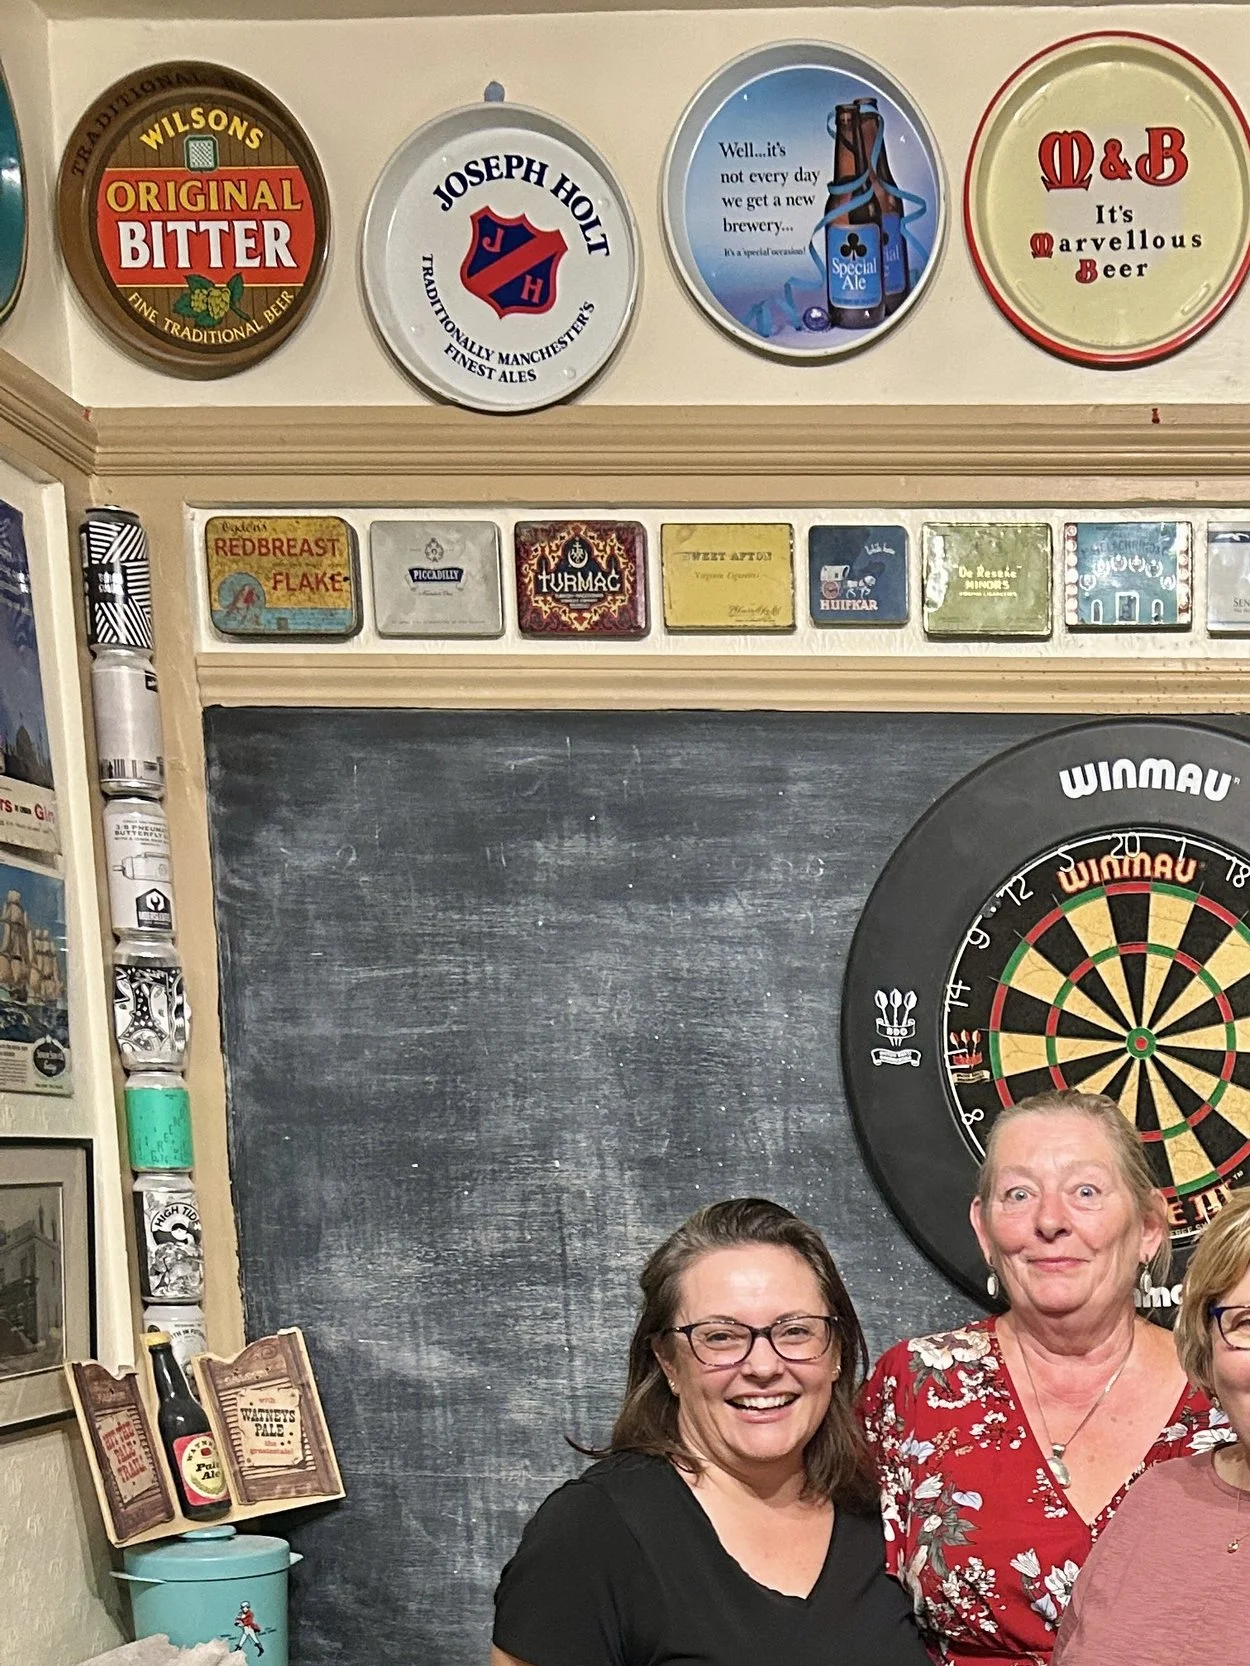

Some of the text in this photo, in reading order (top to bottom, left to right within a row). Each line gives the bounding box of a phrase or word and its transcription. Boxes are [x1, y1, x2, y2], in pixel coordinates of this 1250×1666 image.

[139, 106, 264, 150] WILSONS
[720, 166, 821, 187] not every day
[106, 178, 302, 213] ORIGINAL
[433, 154, 610, 257] JOSEPH HOLT
[722, 193, 816, 212] we get a new
[1095, 204, 1134, 225] It's
[117, 219, 298, 269] BITTER
[1030, 229, 1203, 259] Marvellous
[832, 258, 877, 279] Special
[1075, 258, 1148, 284] Beer
[842, 275, 867, 291] Ale
[128, 290, 295, 344] FINE TRADITIONAL BEER
[422, 253, 595, 366] TRADITIONALLY MANCHESTER'S
[444, 343, 537, 383] FINEST ALES
[214, 537, 340, 558] REDBREAST
[682, 551, 725, 562] SWEET
[271, 571, 344, 593] FLAKE
[413, 569, 460, 581] PICCADILLY
[537, 563, 621, 593] TURMAC
[965, 580, 1010, 590] MINORS
[820, 600, 879, 611] HUIFKAR
[1059, 758, 1232, 801] WINMAU
[114, 830, 163, 839] BUTTERFLY
[1110, 833, 1140, 859] 20
[1056, 852, 1198, 894] WINMAU
[1226, 857, 1250, 888] 18
[998, 876, 1033, 907] 12
[943, 978, 972, 1012] 14
[887, 1028, 908, 1036] BDO
[962, 1108, 985, 1126] 8
[155, 1205, 201, 1227] HIGH TIDE
[240, 1408, 295, 1423] WATNEYS
[255, 1425, 284, 1437] PALE
